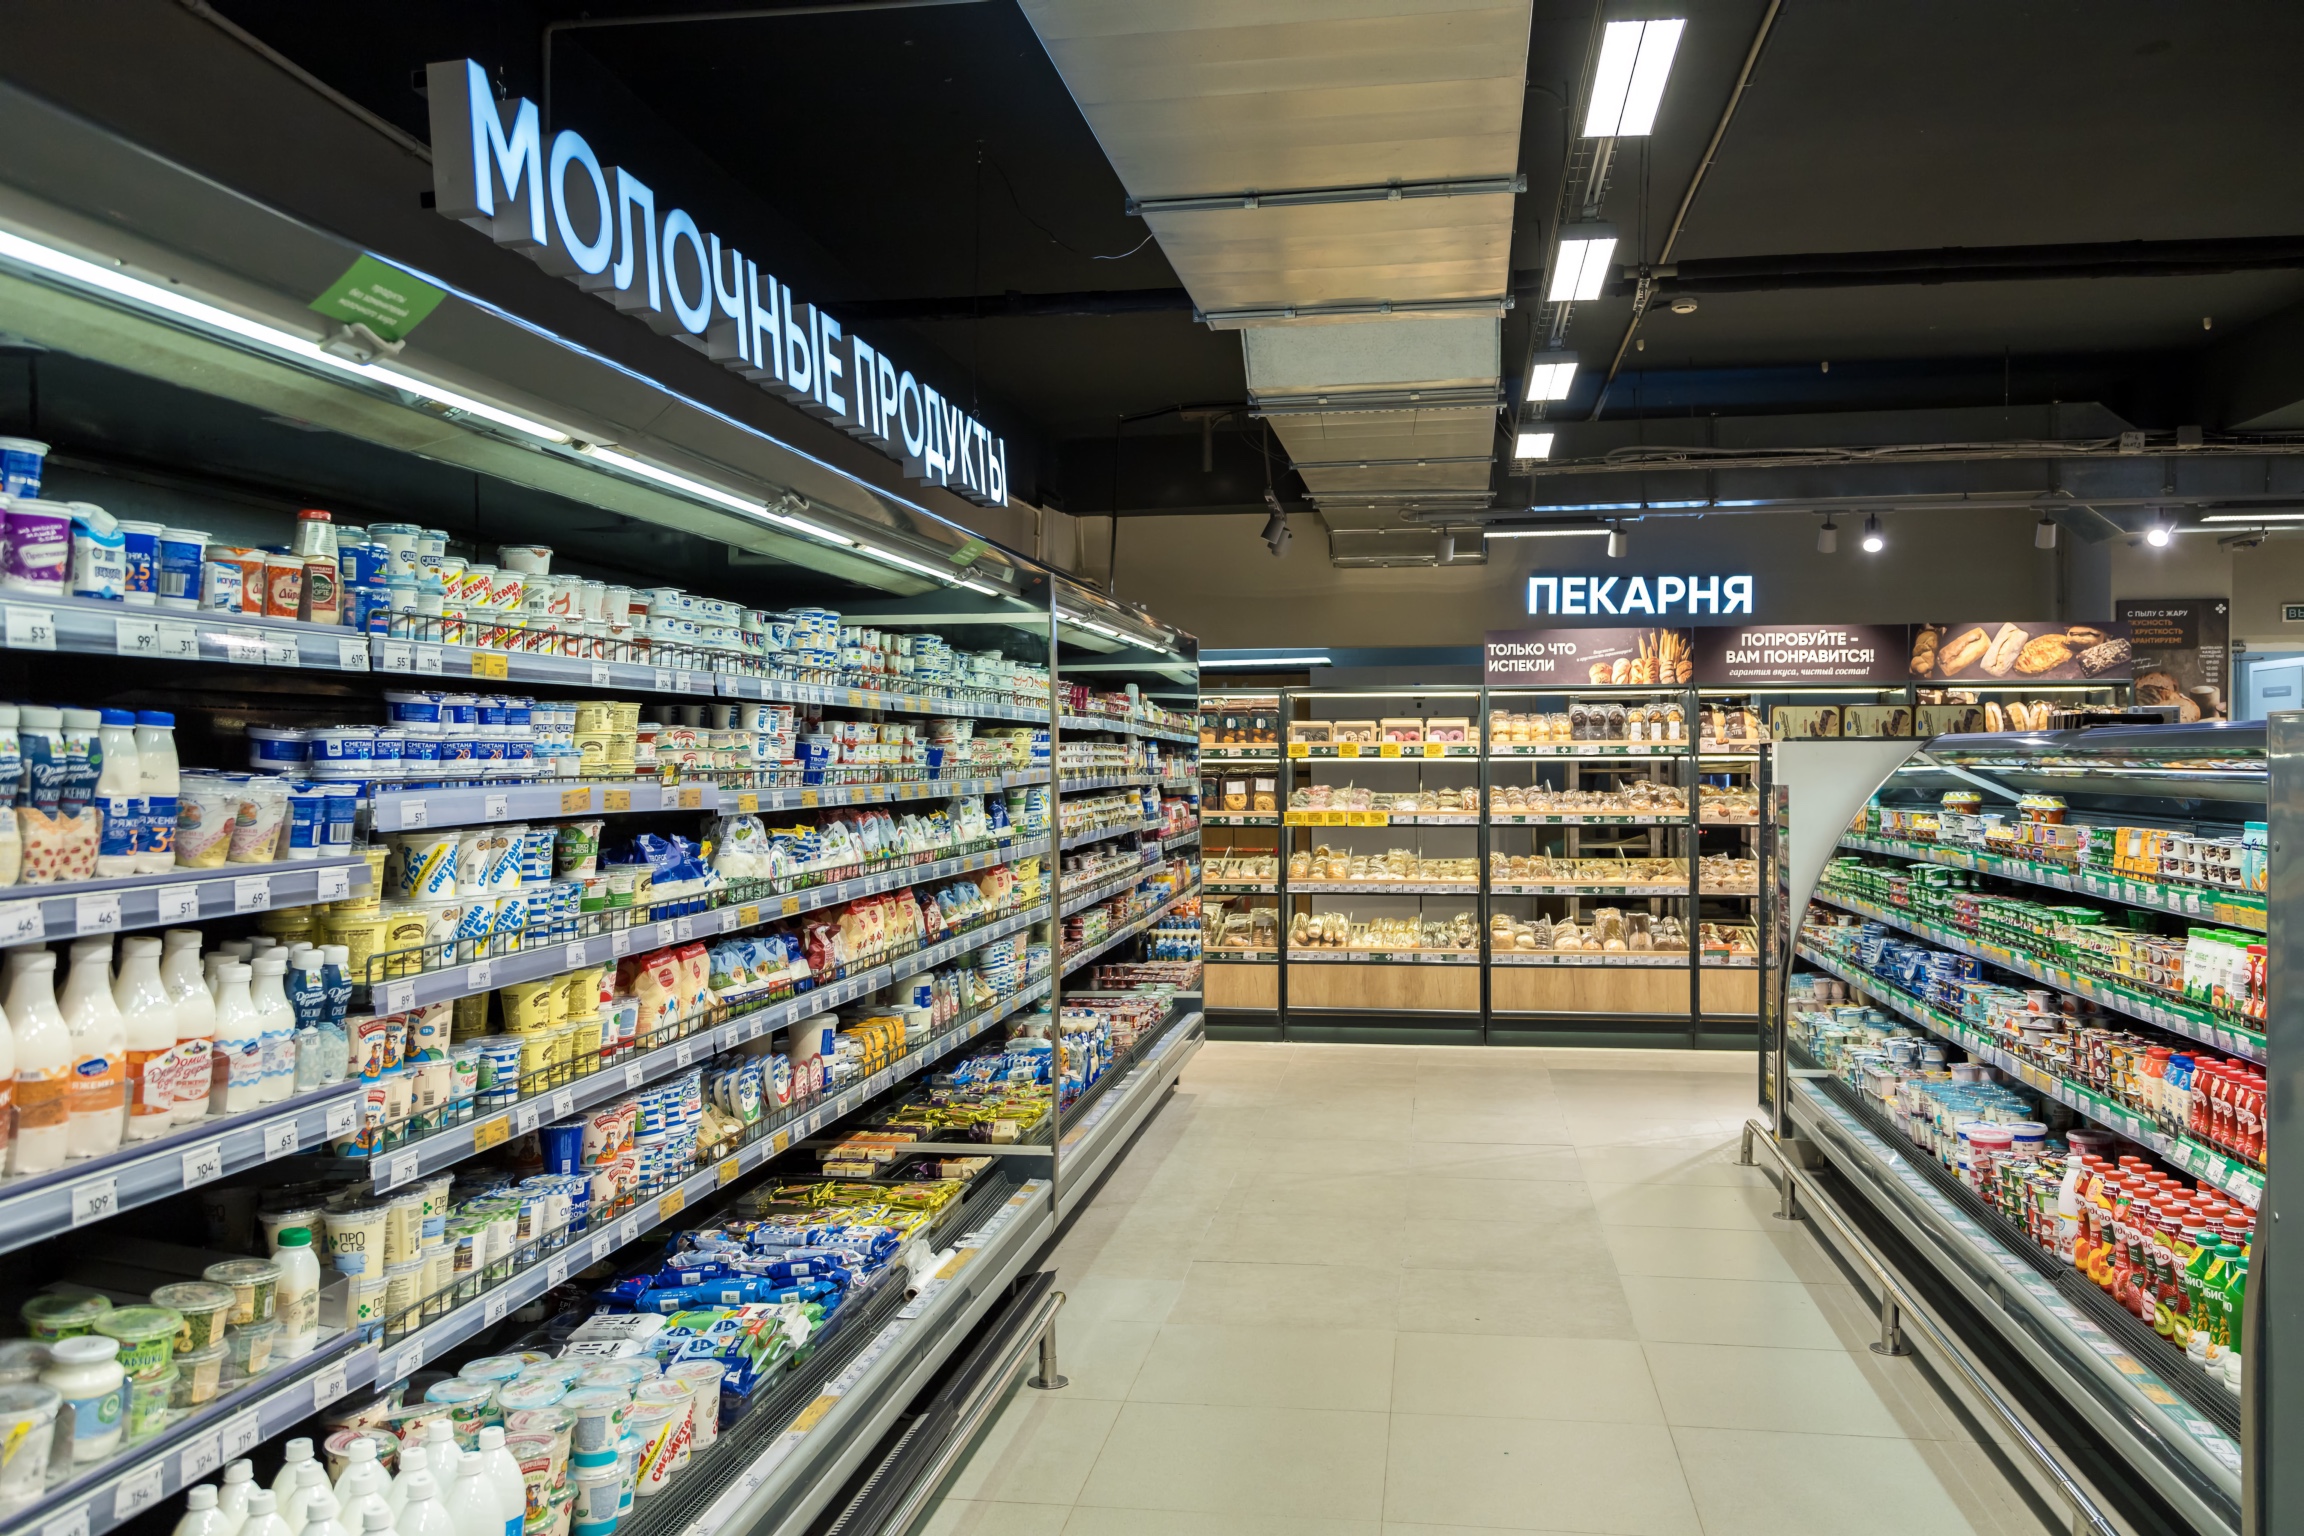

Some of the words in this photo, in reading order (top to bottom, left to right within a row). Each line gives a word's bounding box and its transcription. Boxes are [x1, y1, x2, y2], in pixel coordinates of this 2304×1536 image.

[467, 58, 845, 416] МОЛОЧНЫЕ
[853, 334, 1008, 508] ПРОДУКТЫ
[1528, 576, 1753, 614] ПЕКАРНЯ
[31, 627, 46, 639] 53
[1742, 630, 1846, 646] ПОПРОБУЙТЕ
[138, 636, 150, 647] 99
[181, 640, 191, 652] 31
[282, 649, 292, 659] 37
[1488, 643, 1545, 655] ТОЛЬКО
[1548, 643, 1577, 655] ЧТО
[397, 657, 406, 667] 55
[1726, 650, 1760, 663] ВАМ
[1764, 649, 1875, 663] ПОНРАВИТСЯ!
[1488, 659, 1554, 672] ИСПЕКЛИ
[1729, 668, 1771, 677] гарантия
[1772, 669, 1799, 677] вкуса,
[1801, 667, 1834, 676] чистый
[1835, 666, 1870, 676] состав!
[252, 893, 263, 904] 69
[99, 913, 113, 925] 46
[401, 995, 410, 1006] 89
[340, 1116, 351, 1127] 46
[281, 1135, 292, 1146] 63
[196, 1163, 214, 1176] 104
[404, 1166, 412, 1177] 79
[88, 1195, 108, 1210] 109
[330, 1381, 340, 1394] 89
